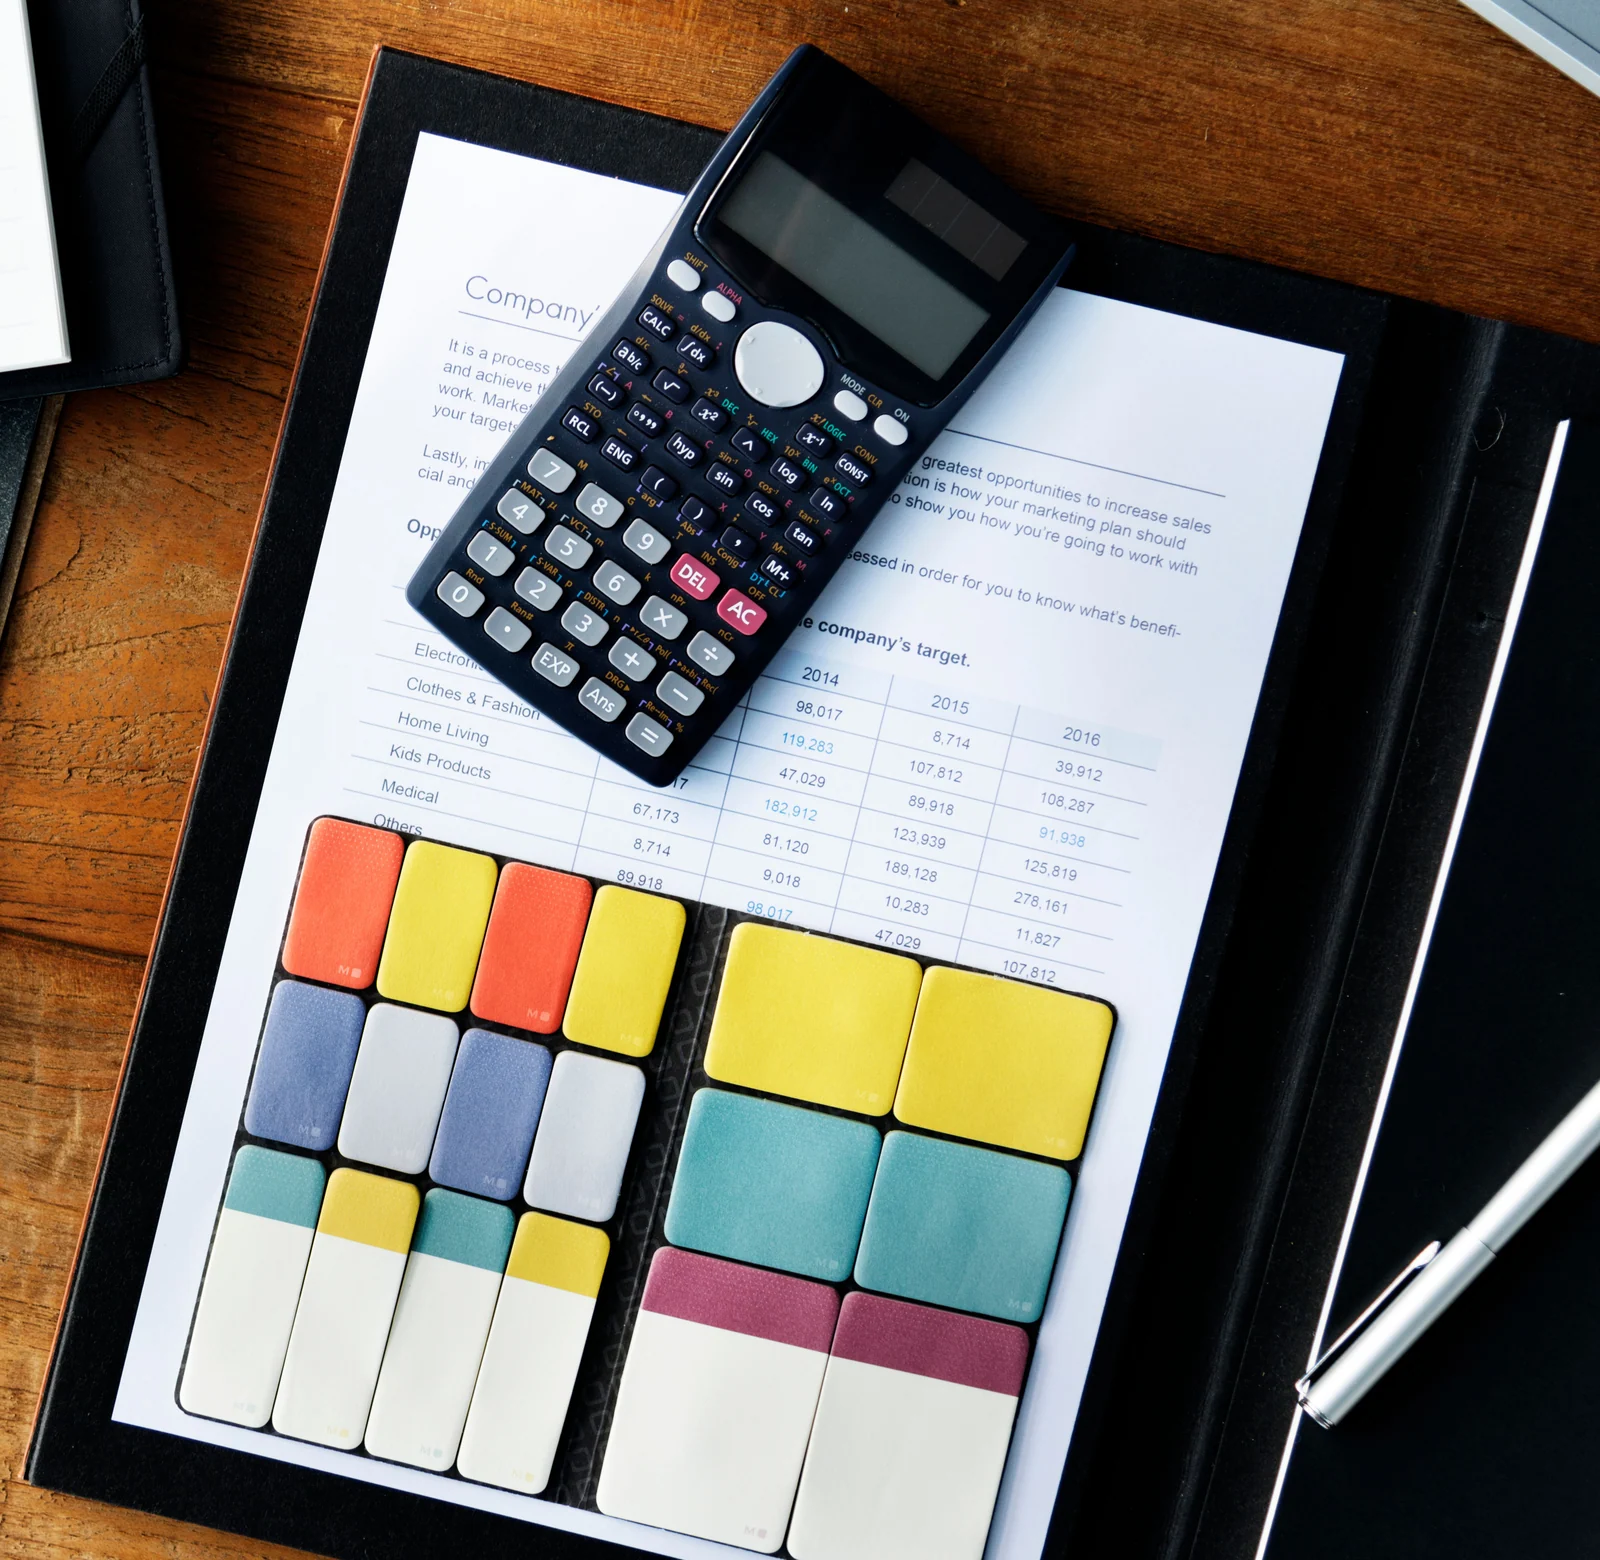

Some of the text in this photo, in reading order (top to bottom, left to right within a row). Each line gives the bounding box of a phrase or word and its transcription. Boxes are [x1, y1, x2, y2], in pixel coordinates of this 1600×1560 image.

[684, 252, 708, 272] SHIFT
[651, 294, 674, 313] SOLVE
[717, 282, 743, 305] ALPHA
[642, 311, 671, 337] CALC
[449, 339, 459, 352] It
[463, 343, 475, 358] is
[479, 348, 488, 360] a
[492, 350, 550, 375] process
[443, 361, 470, 378] and
[476, 369, 533, 392] achieve
[840, 374, 866, 396] MODE
[438, 383, 476, 402] work.
[867, 394, 883, 409] CLR
[432, 404, 464, 422] your
[584, 401, 602, 419] STO
[722, 398, 739, 414] DEC
[894, 408, 910, 424] ON
[568, 414, 590, 436] RCL
[761, 428, 779, 444] HEX
[823, 420, 847, 442] LOGIC
[423, 444, 468, 469] Lastly,
[606, 441, 633, 466] ENG
[672, 437, 696, 461] hyp
[854, 445, 878, 465] CONV
[418, 466, 444, 482] cial
[543, 461, 560, 479] 7
[778, 462, 798, 484] log
[802, 458, 818, 474] BIN
[838, 458, 868, 482] CONST
[520, 482, 542, 500] MAT
[714, 472, 734, 489] sin
[834, 482, 851, 498] OCT
[590, 497, 608, 516] 8
[641, 492, 656, 508] arg
[922, 455, 1212, 536] greatest opportunities to increase sales
[512, 503, 528, 521] 4
[752, 500, 774, 518] cos
[934, 478, 946, 492] is
[950, 482, 982, 501] how
[986, 491, 1018, 510] your
[1022, 500, 1096, 532] marketing
[1099, 518, 1132, 540] plan
[1136, 526, 1186, 552] should
[488, 521, 513, 543] S-SUM
[569, 516, 588, 534] VCT
[680, 520, 696, 537] Abs
[560, 537, 578, 556] 5
[637, 532, 655, 551] 9
[793, 527, 814, 549] tan
[904, 496, 945, 516] show
[948, 506, 976, 523] you
[980, 512, 1011, 532] how
[1064, 532, 1106, 557] going
[1109, 542, 1124, 558] to
[1128, 546, 1164, 570] work
[1167, 554, 1199, 577] with
[484, 546, 498, 562] 1
[701, 551, 717, 568] INS
[717, 547, 740, 569] Conjg
[466, 568, 485, 585] Rnd
[536, 557, 559, 577] S-VAR
[678, 563, 706, 593] DEL
[766, 559, 790, 582] M+
[529, 579, 547, 600] 2
[608, 574, 626, 593] 6
[750, 572, 764, 586] DT
[452, 584, 470, 603] 0
[584, 591, 606, 612] DISTR
[670, 593, 686, 607] nPr
[748, 586, 766, 602] OFF
[901, 558, 916, 574] in
[918, 565, 958, 586] order
[962, 573, 984, 591] for
[985, 582, 1014, 601] you
[1017, 586, 1032, 602] to
[1035, 591, 1076, 614] know
[1130, 614, 1182, 640] benefi-
[510, 601, 534, 622] Ran#
[727, 601, 757, 625] AC
[575, 614, 593, 634] 3
[718, 628, 735, 643] nCr
[540, 651, 572, 677] EXP
[916, 640, 972, 668] target.
[605, 672, 625, 690] DRG
[802, 667, 840, 688] 2014
[406, 676, 541, 721] Clothes & Fashion
[587, 688, 616, 714] Ans
[931, 694, 970, 716] 2015
[795, 700, 844, 724] 98,017
[397, 711, 490, 748] Home Living
[933, 730, 971, 751] 8,714
[1062, 726, 1102, 748] 2016
[781, 732, 835, 756] 119,283
[389, 744, 492, 780] Kids Products
[908, 760, 964, 784] 107,812
[1054, 760, 1103, 782] 39,912
[778, 767, 827, 788] 47,029
[381, 778, 440, 804] Medical
[632, 802, 680, 824] 67,173
[763, 798, 818, 822] 182,912
[908, 795, 955, 816] 89,918
[1040, 792, 1095, 816] 108,287
[373, 814, 423, 836] Others
[633, 838, 672, 858] 8,714
[762, 834, 810, 856] 81,120
[892, 827, 946, 850] 123,939
[1038, 826, 1086, 848] 91,938
[616, 870, 664, 891] 89,918
[762, 868, 802, 890] 9,018
[883, 860, 938, 884] 189,128
[1022, 858, 1078, 882] 125,819
[746, 900, 794, 922] 98,017
[884, 896, 930, 918] 10,283
[1013, 891, 1068, 916] 278,161
[874, 928, 922, 951] 47,029
[1015, 927, 1062, 950] 11,827
[1002, 960, 1057, 984] 107,812
